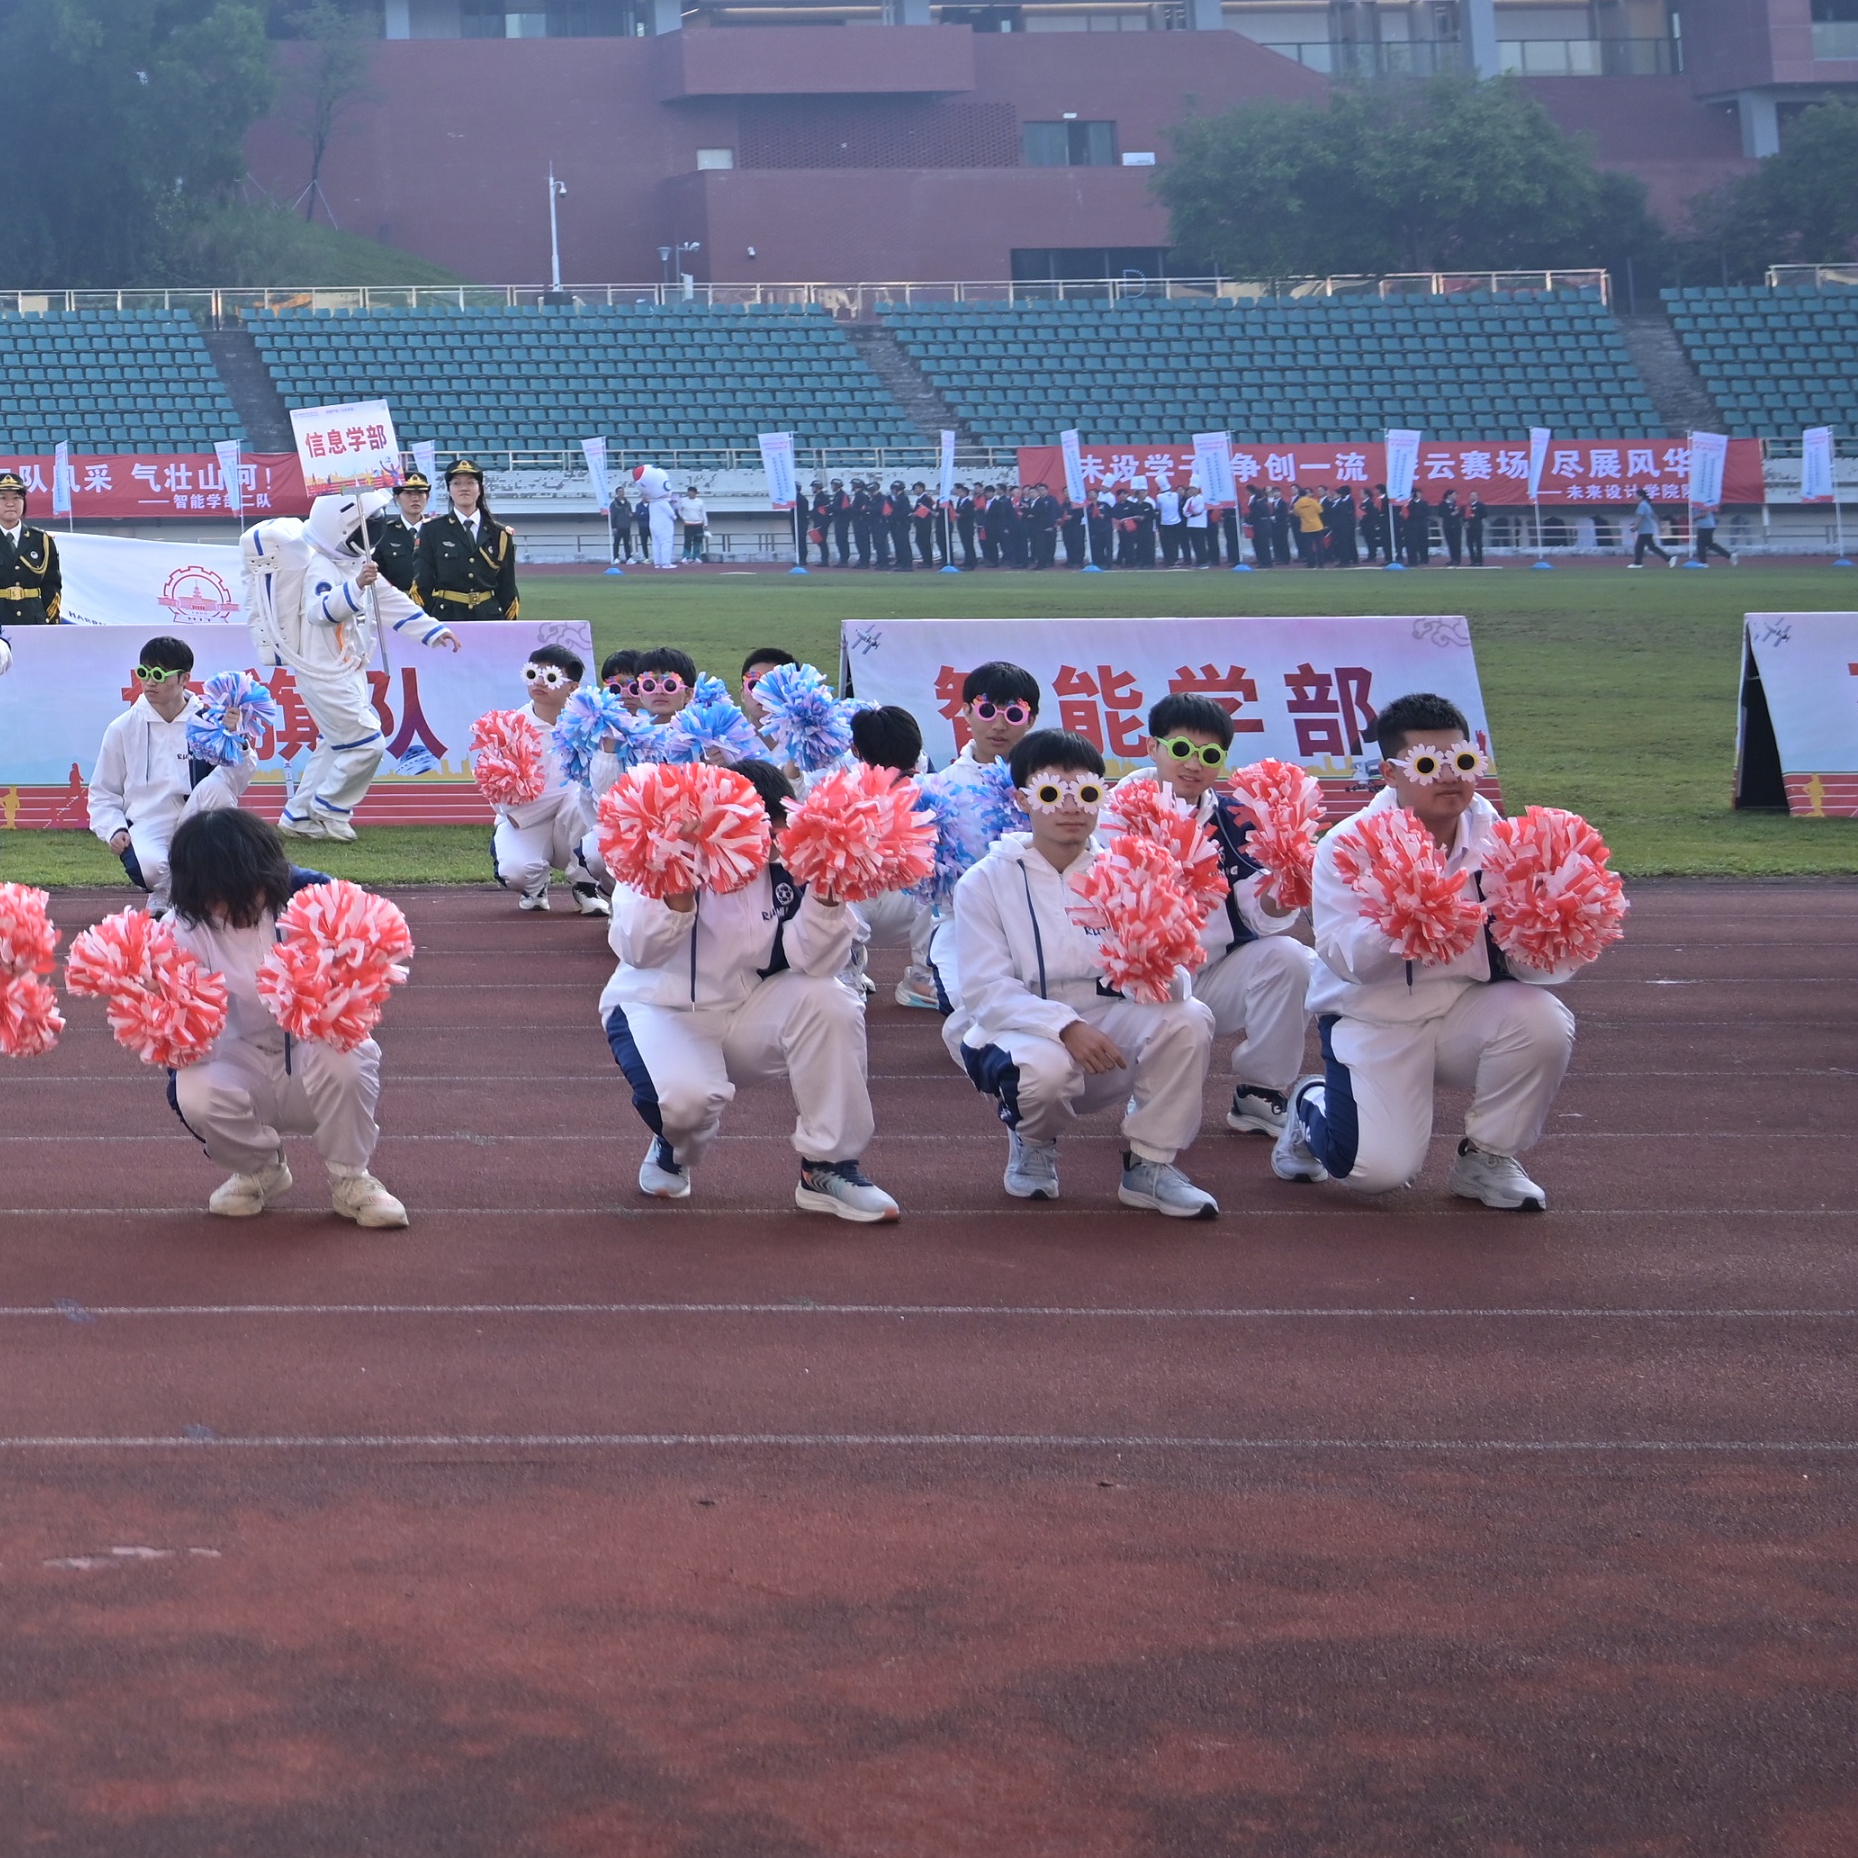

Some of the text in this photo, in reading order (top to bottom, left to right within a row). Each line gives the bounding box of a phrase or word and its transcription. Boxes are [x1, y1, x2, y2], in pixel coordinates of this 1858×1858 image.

[305, 424, 387, 459] 信息学部
[1231, 452, 1368, 483] 争创一流
[1413, 450, 1530, 480] 云赛场
[1551, 448, 1692, 479] 尽展风华
